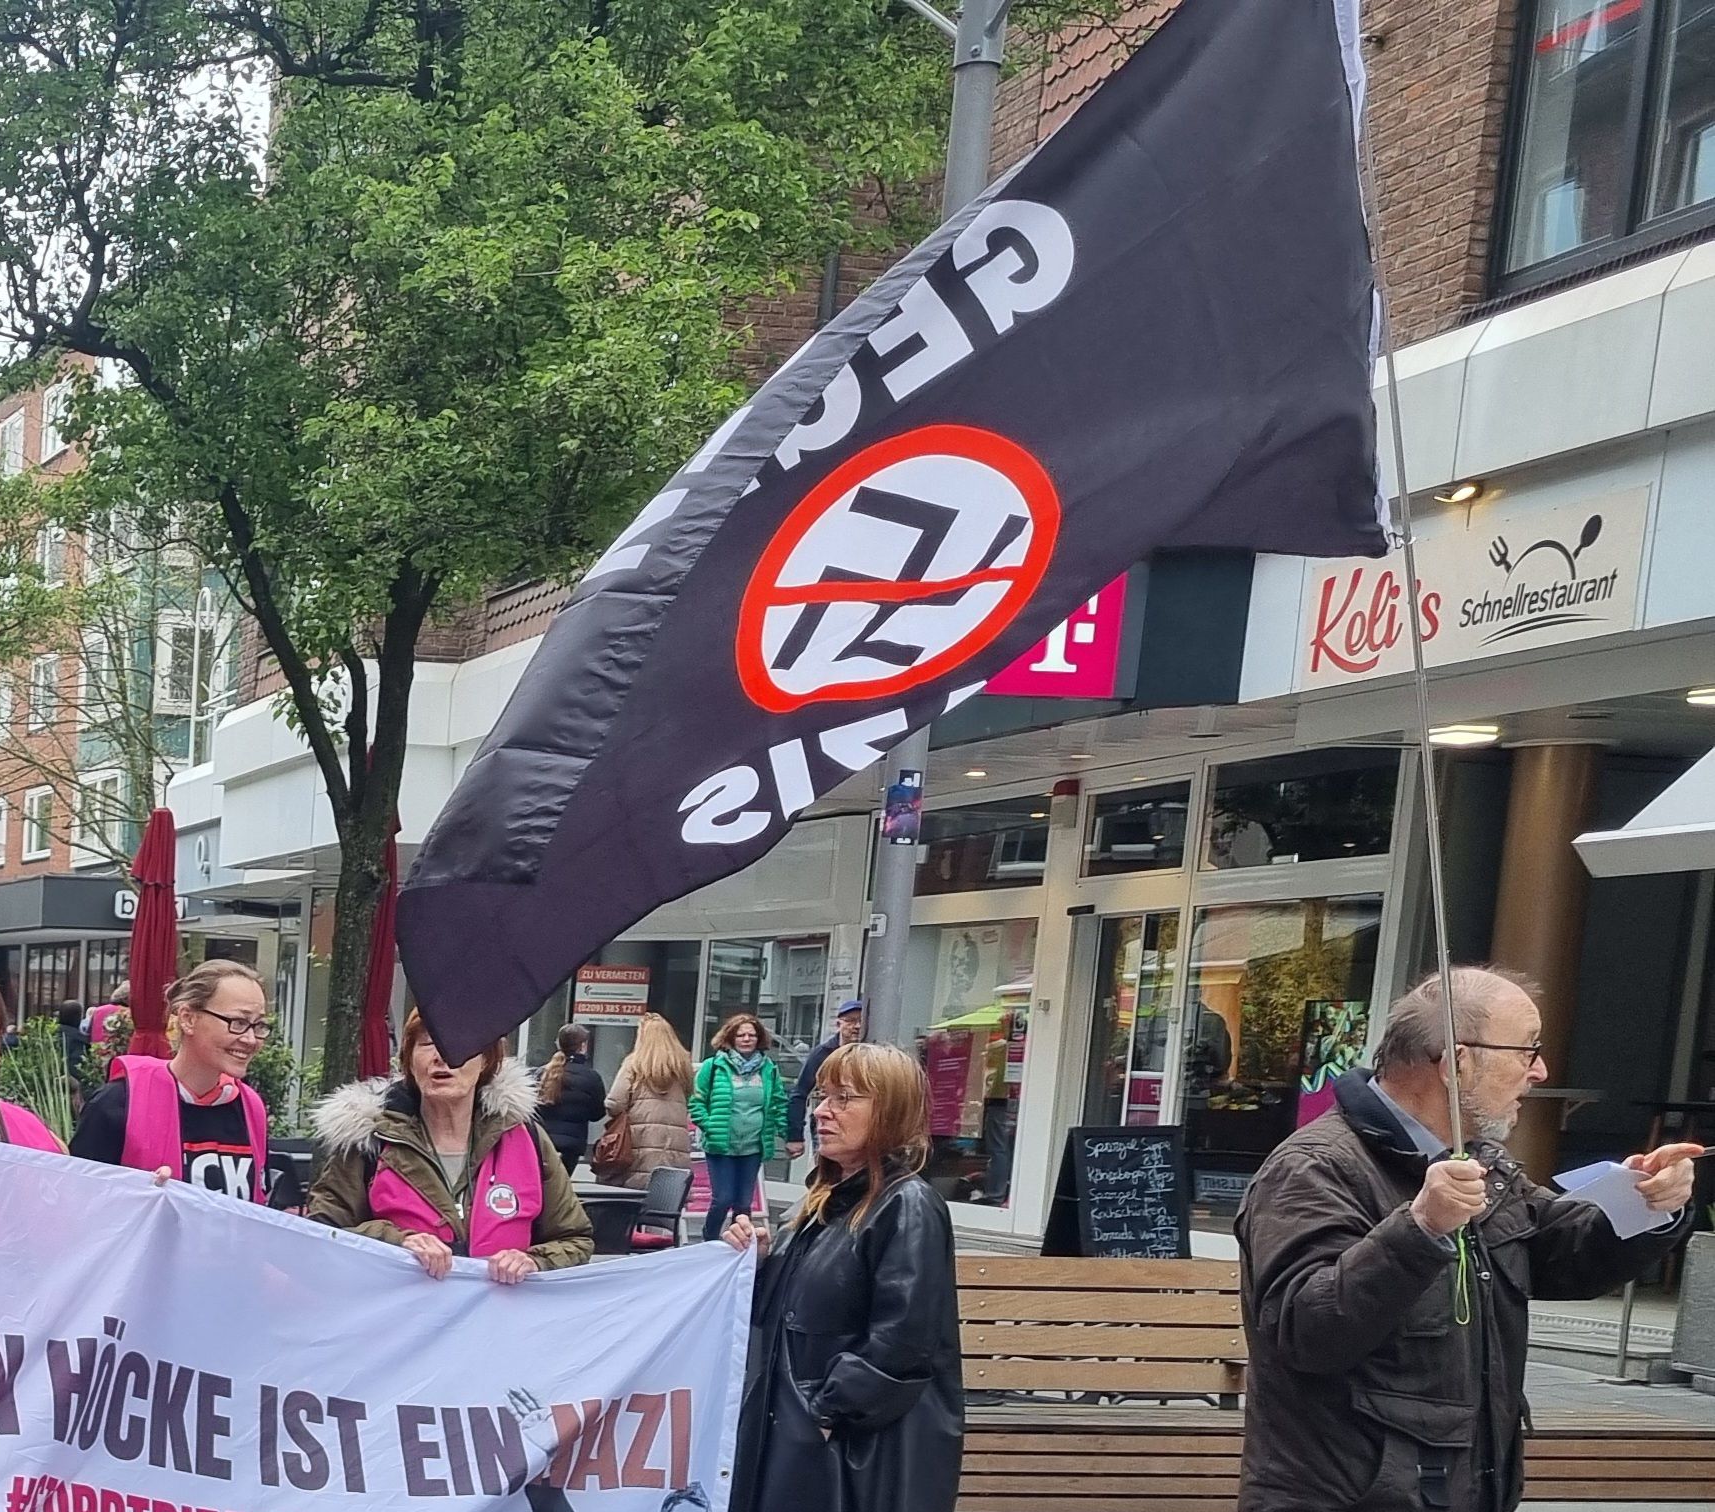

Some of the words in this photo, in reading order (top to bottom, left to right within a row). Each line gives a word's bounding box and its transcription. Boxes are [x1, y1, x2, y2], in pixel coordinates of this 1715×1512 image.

[1458, 568, 1618, 629] Schnellrestaurant
[595, 970, 646, 981] VERMIETEN
[184, 1152, 253, 1201] CK
[47, 1315, 234, 1482] HÖCKE
[259, 1384, 368, 1494] IST
[396, 1404, 528, 1497] EIN
